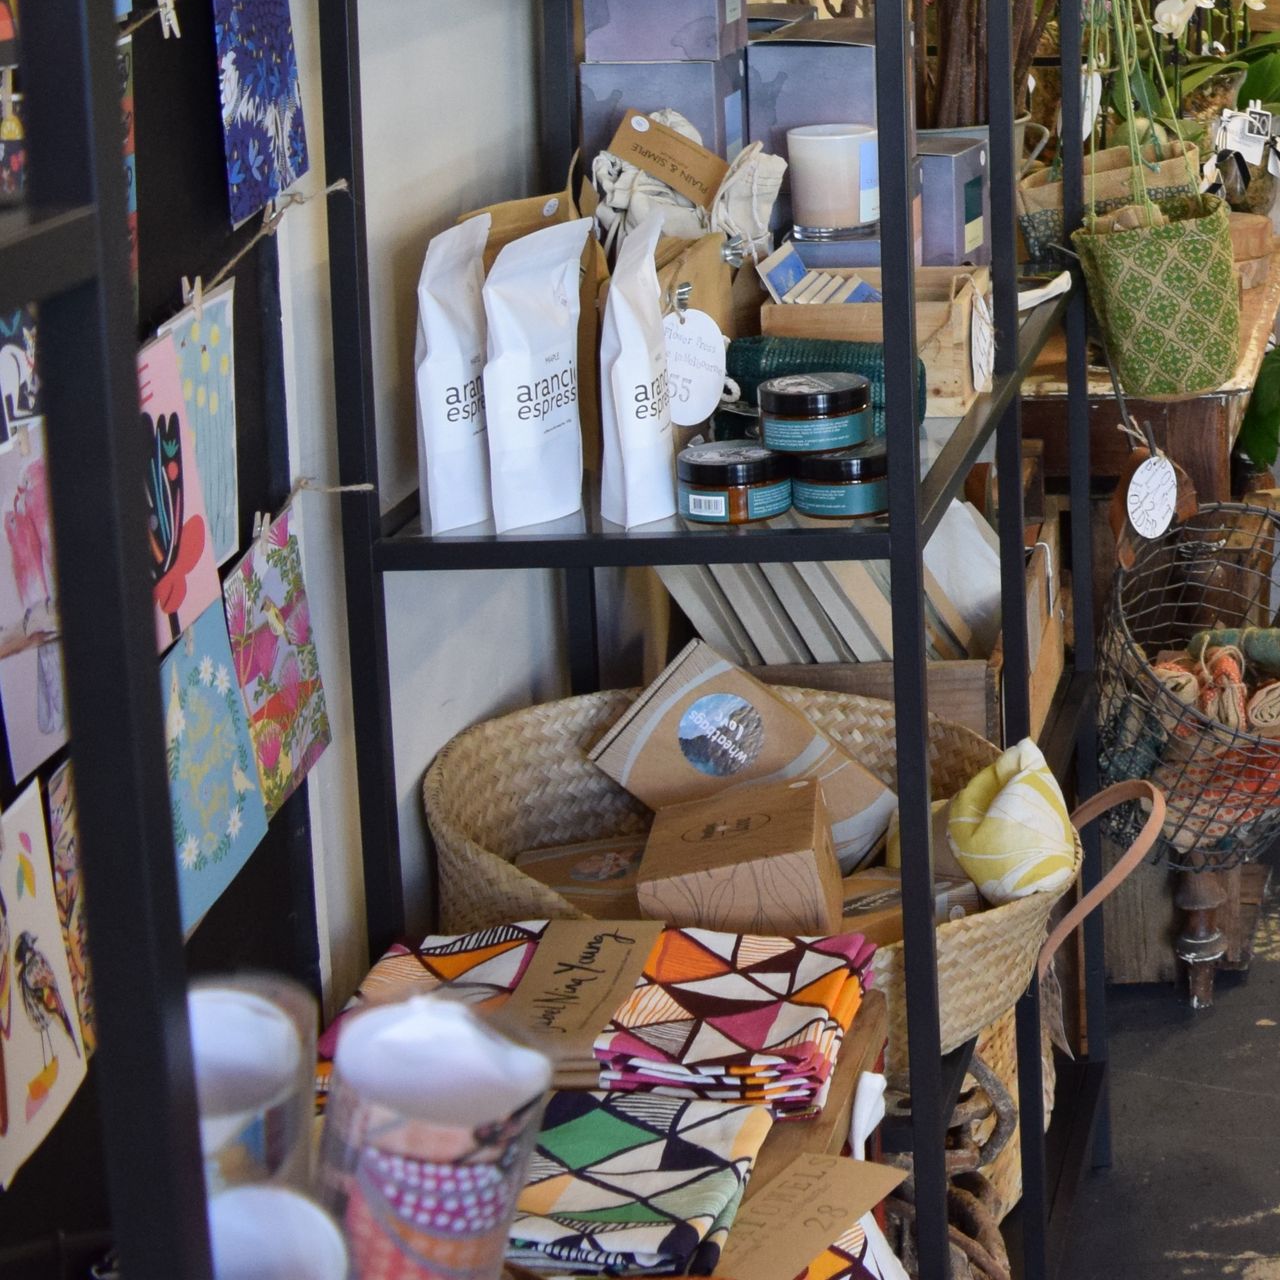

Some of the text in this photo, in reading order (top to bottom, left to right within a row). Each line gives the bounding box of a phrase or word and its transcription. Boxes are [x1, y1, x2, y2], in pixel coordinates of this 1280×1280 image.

[631, 143, 668, 168] SIMPLE
[669, 163, 679, 173] &
[680, 170, 710, 195] PLAIN
[544, 351, 561, 364] MAPLE
[445, 373, 483, 405] aran
[516, 360, 576, 404] aranci
[446, 397, 485, 422] espre
[517, 386, 576, 423] espress
[688, 709, 748, 765] wheatbags
[553, 928, 636, 974] Young
[733, 1155, 838, 1230] TOWELS
[803, 1204, 849, 1232] 28
